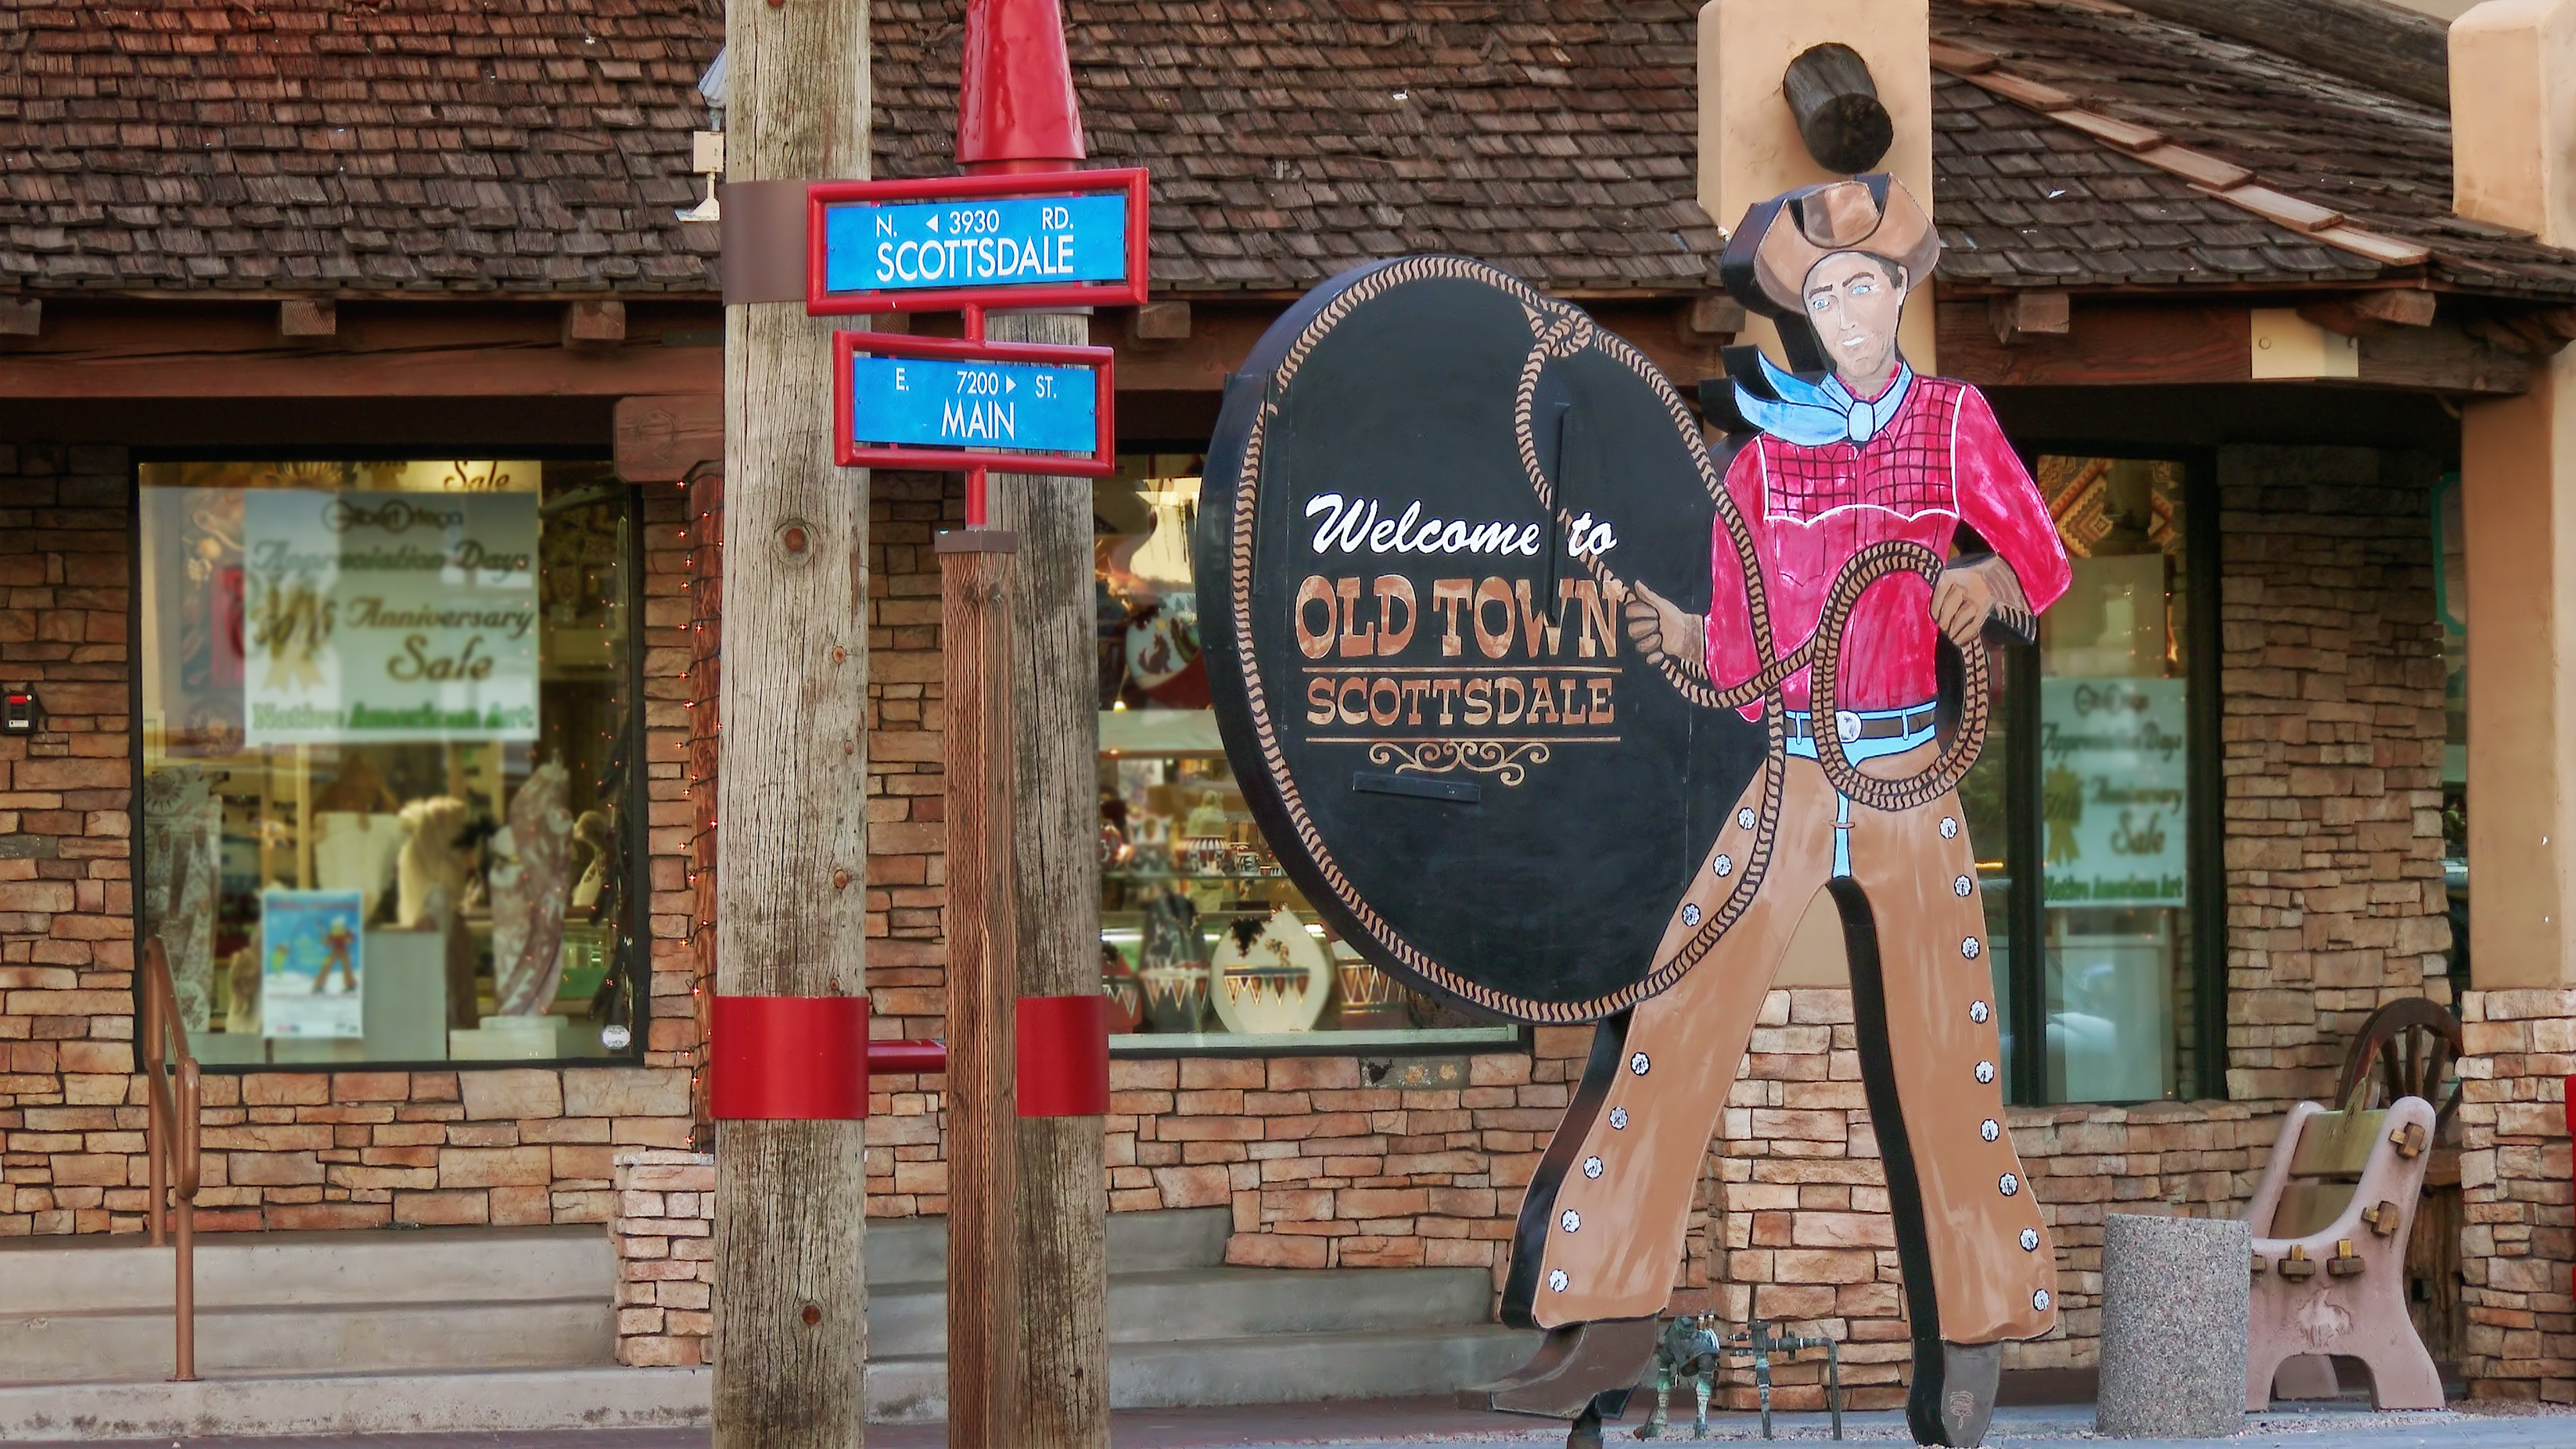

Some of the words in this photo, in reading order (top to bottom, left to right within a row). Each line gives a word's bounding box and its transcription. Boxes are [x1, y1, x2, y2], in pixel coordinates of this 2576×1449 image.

[875, 214, 898, 239] N.
[949, 209, 1000, 235] 3930
[1042, 206, 1074, 232] RD.
[875, 235, 1074, 282] SCOTTSDALE
[895, 367, 910, 392] E.
[957, 370, 999, 396] 7200
[1035, 375, 1057, 399] ST.
[941, 397, 1015, 440] MAIN
[1303, 492, 1542, 558] Welcome
[1566, 510, 1619, 558] to
[452, 539, 530, 582] Days
[346, 597, 535, 640] Anniversary
[1295, 573, 1418, 660] OLD
[1432, 576, 1621, 659] TOWN
[386, 635, 494, 682] Sale
[1306, 676, 1615, 726] SCOTTSDALE
